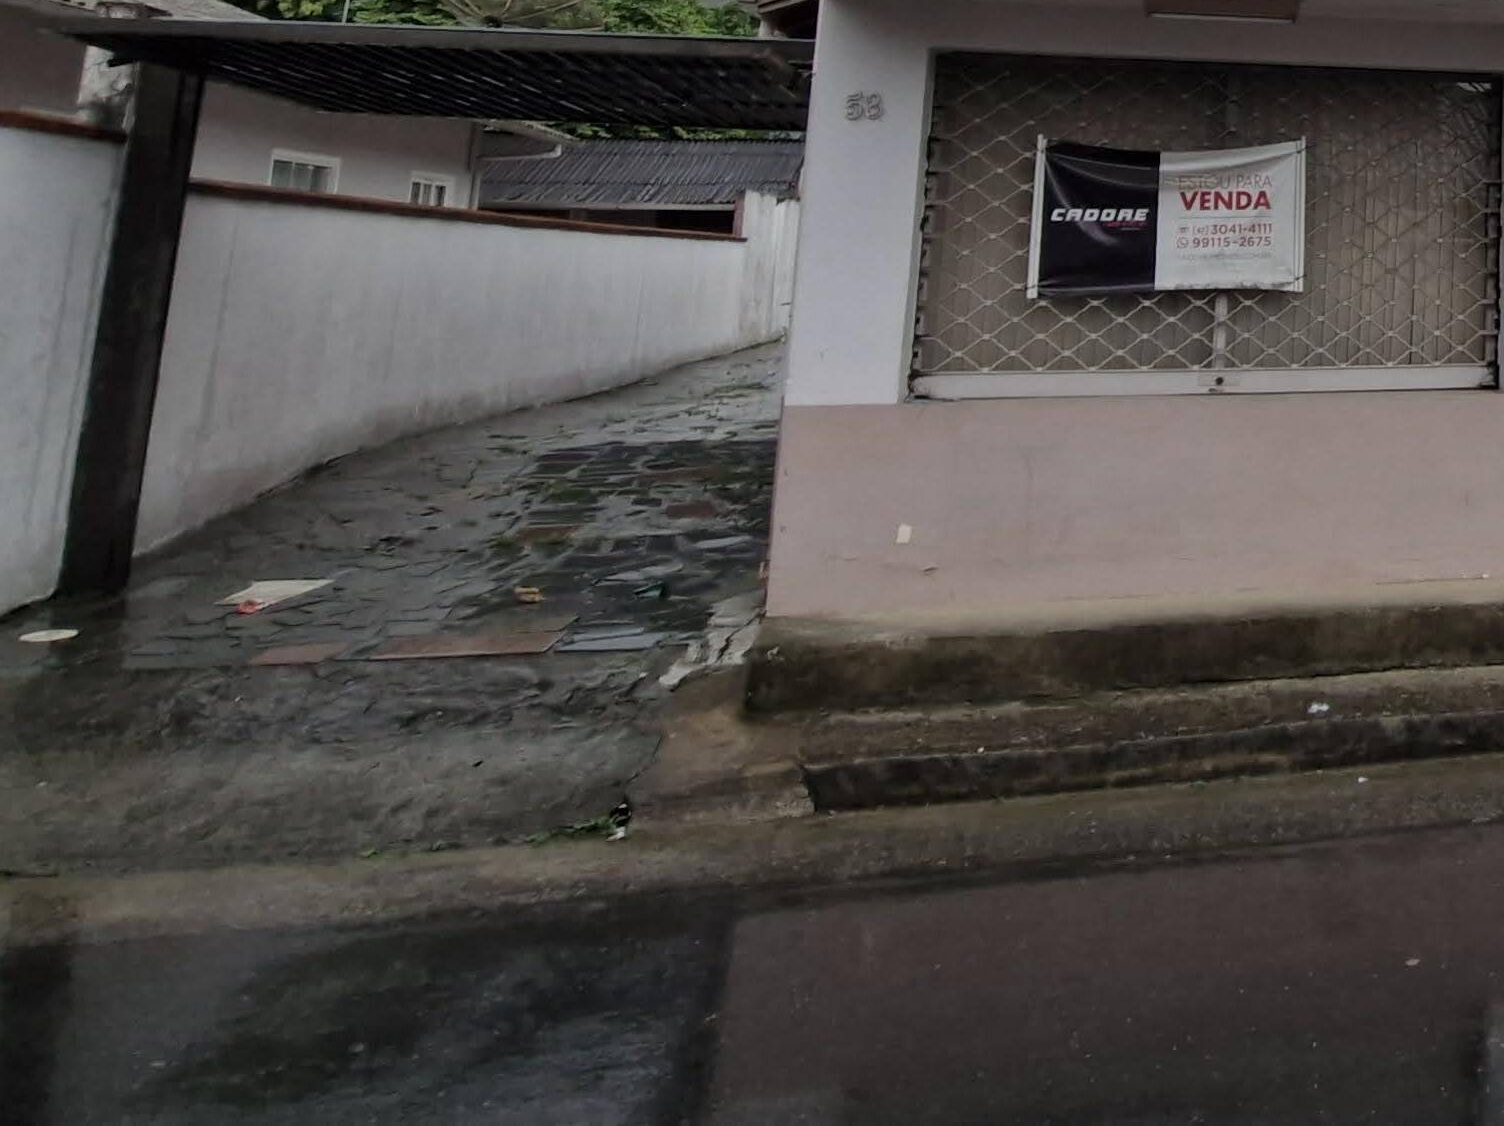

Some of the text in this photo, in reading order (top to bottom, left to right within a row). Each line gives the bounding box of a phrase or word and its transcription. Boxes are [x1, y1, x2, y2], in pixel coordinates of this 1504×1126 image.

[1236, 174, 1272, 188] PARA
[1179, 190, 1271, 211] VENDA
[1050, 208, 1150, 222] CADORE
[1210, 223, 1273, 235] 3041-4111
[1192, 236, 1272, 248] 99115-2675
